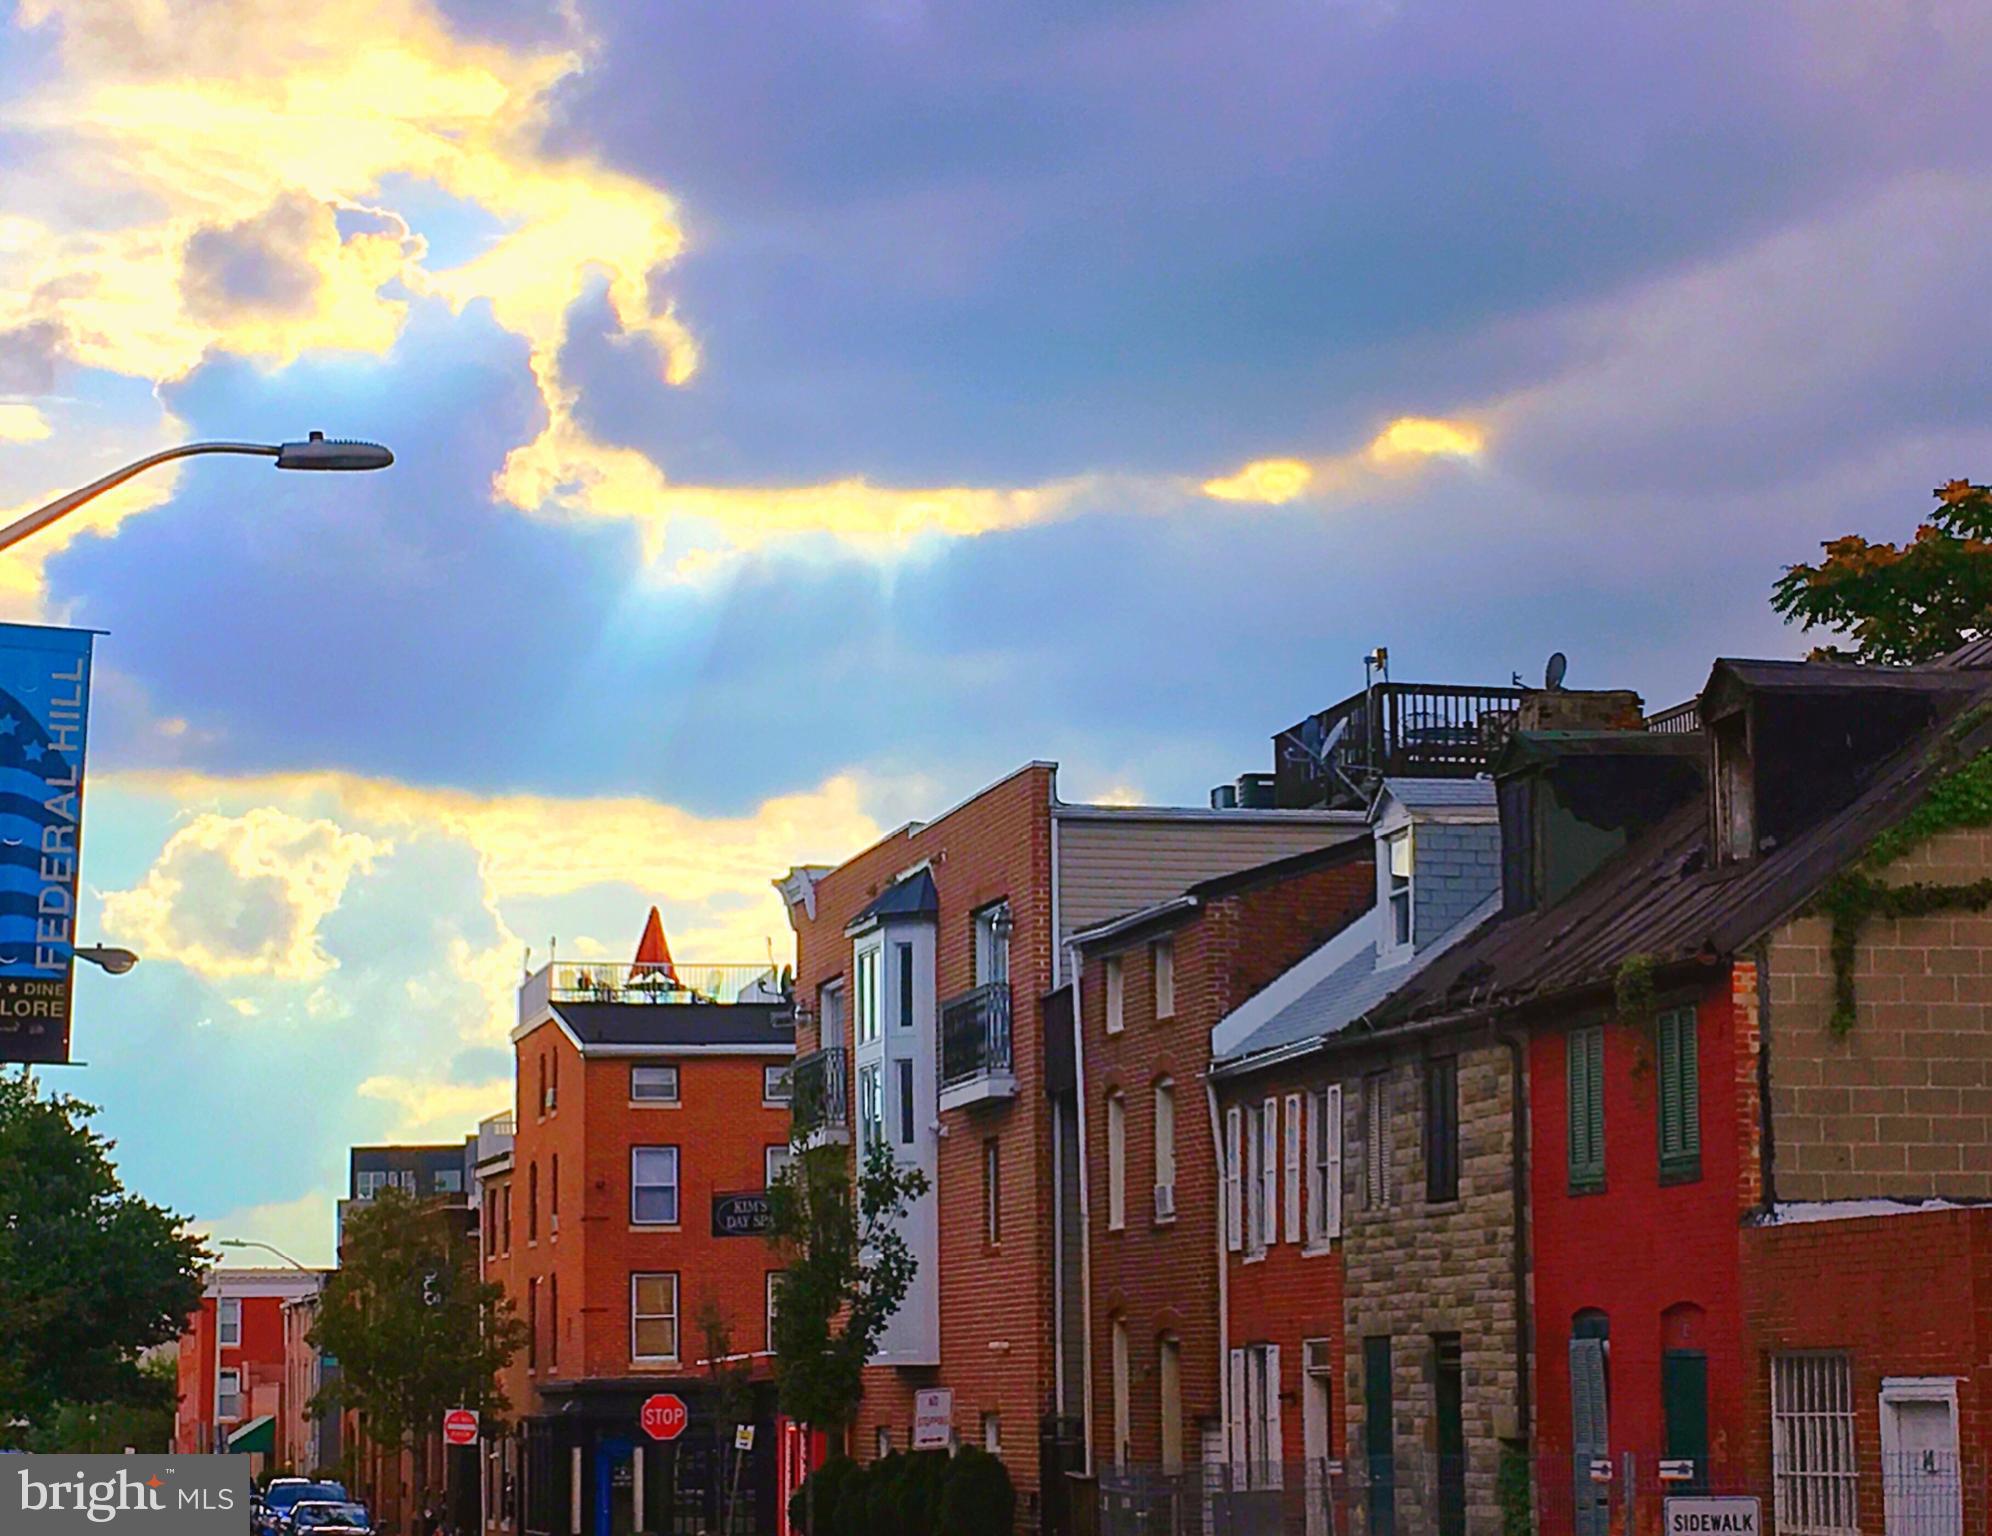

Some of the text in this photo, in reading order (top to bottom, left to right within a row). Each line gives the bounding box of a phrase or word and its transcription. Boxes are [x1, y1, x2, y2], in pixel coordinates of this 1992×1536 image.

[35, 657, 83, 970] FEDERAL HILL
[24, 983, 65, 996] DINE
[726, 1215, 749, 1228] DAY
[645, 1408, 684, 1425] STOP
[1673, 1514, 1753, 1532] SIDEWALK
